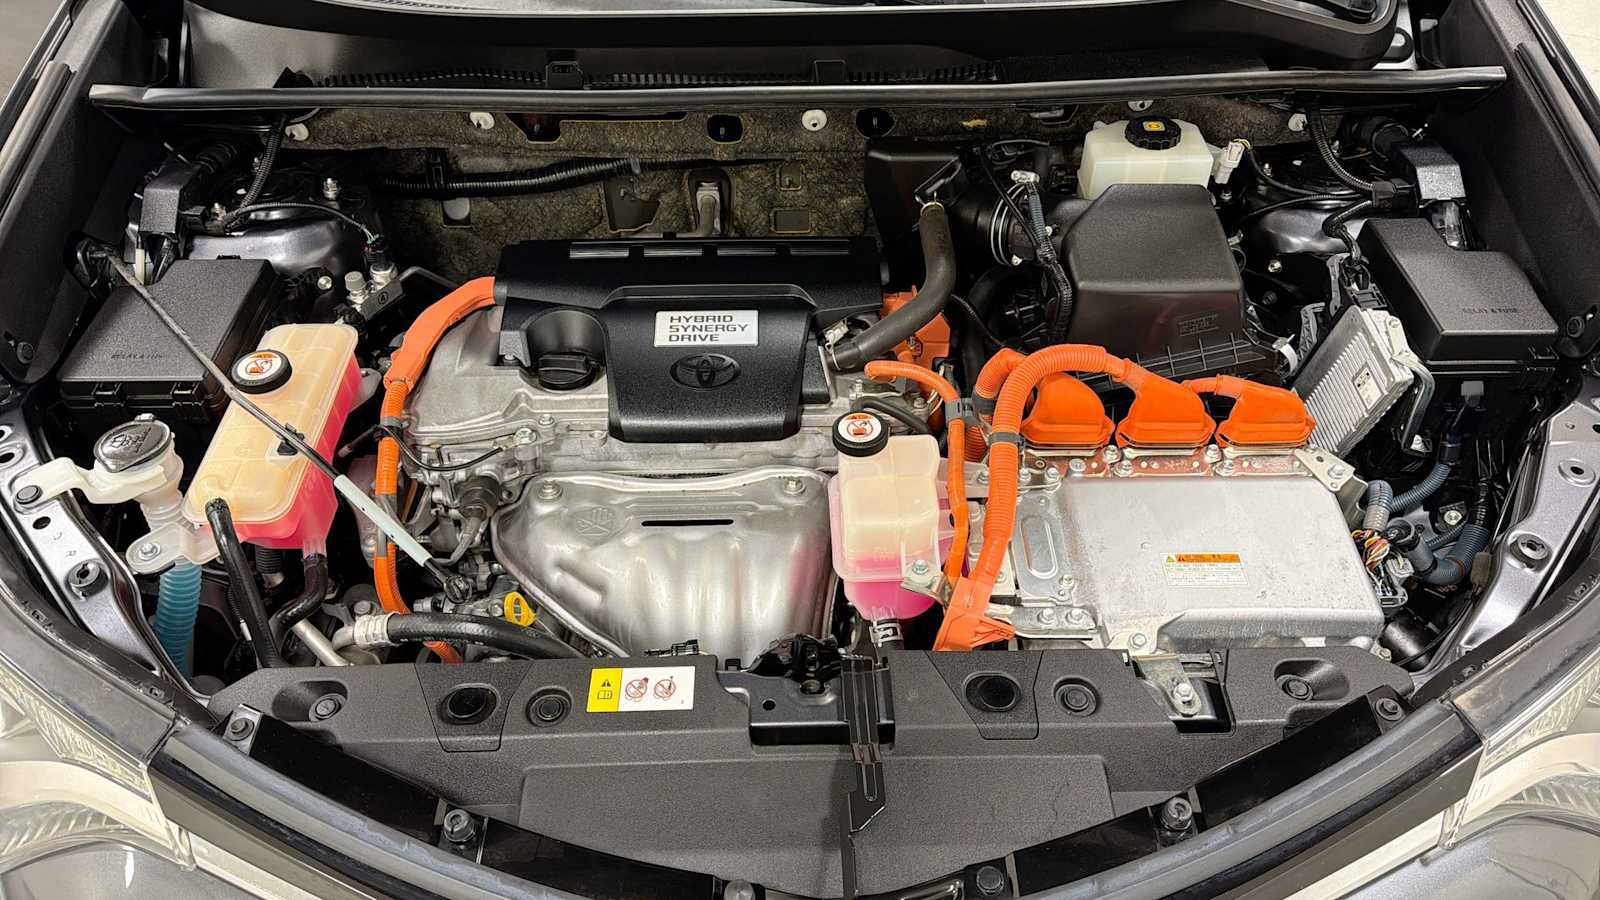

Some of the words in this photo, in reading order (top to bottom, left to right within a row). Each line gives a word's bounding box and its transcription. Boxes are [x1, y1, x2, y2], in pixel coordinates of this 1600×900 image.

[670, 315, 733, 323] HYBRID
[669, 324, 748, 333] SYNERGY
[668, 333, 720, 342] DRIVE
